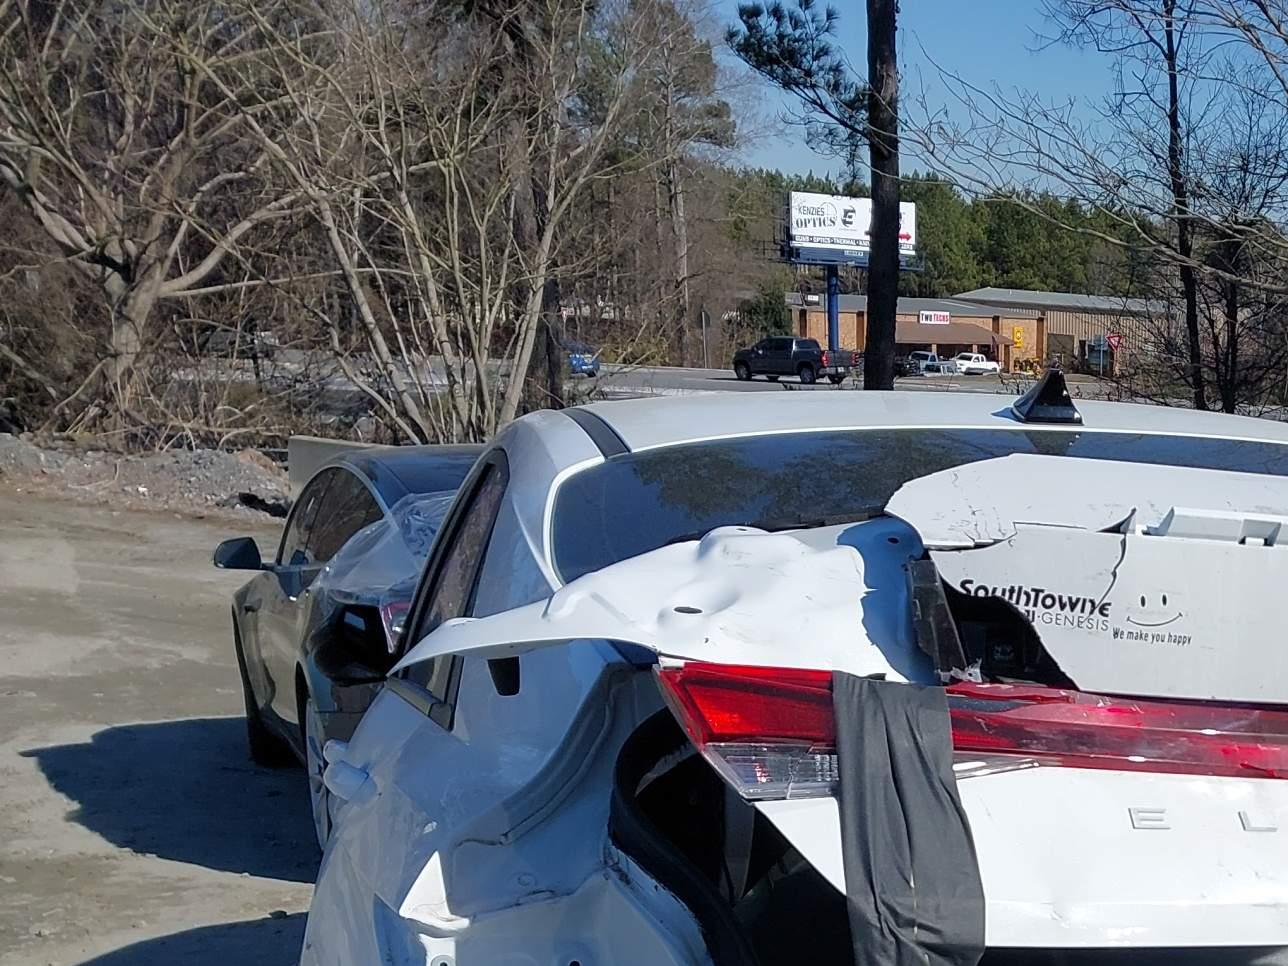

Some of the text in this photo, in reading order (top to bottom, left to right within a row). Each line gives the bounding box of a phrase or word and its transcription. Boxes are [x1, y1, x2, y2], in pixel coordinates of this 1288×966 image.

[796, 217, 836, 228] OPTICS
[1112, 627, 1192, 645] We make you happy
